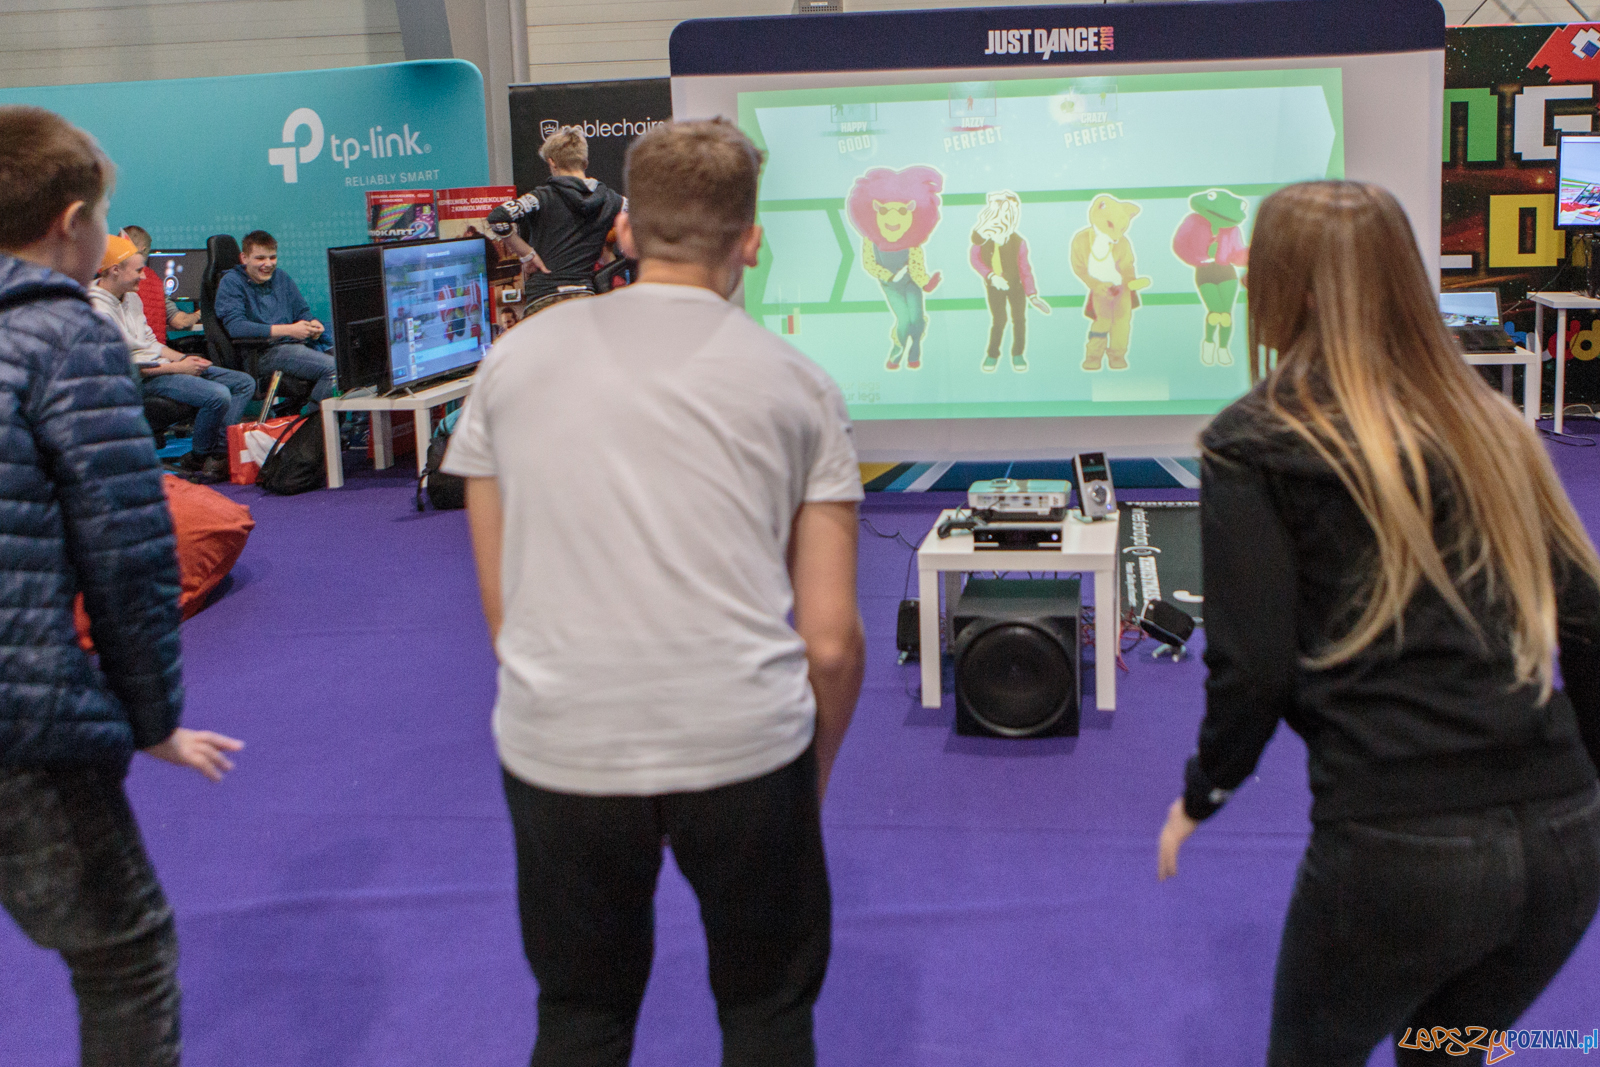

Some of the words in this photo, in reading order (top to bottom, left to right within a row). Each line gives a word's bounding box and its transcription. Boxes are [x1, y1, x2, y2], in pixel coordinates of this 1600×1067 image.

[984, 29, 1032, 55] JUST
[1034, 26, 1099, 60] DANCE
[1099, 26, 1114, 51] 2018
[841, 121, 868, 133] HAPPY
[961, 116, 985, 128] JAZZY
[1081, 112, 1108, 124] CRAZY
[838, 134, 871, 154] GOOD
[943, 126, 1003, 153] PERFECT
[1064, 121, 1124, 149] PERFECT
[330, 124, 424, 169] tp-link
[345, 173, 397, 187] RELIABLY
[399, 169, 440, 183] SMART
